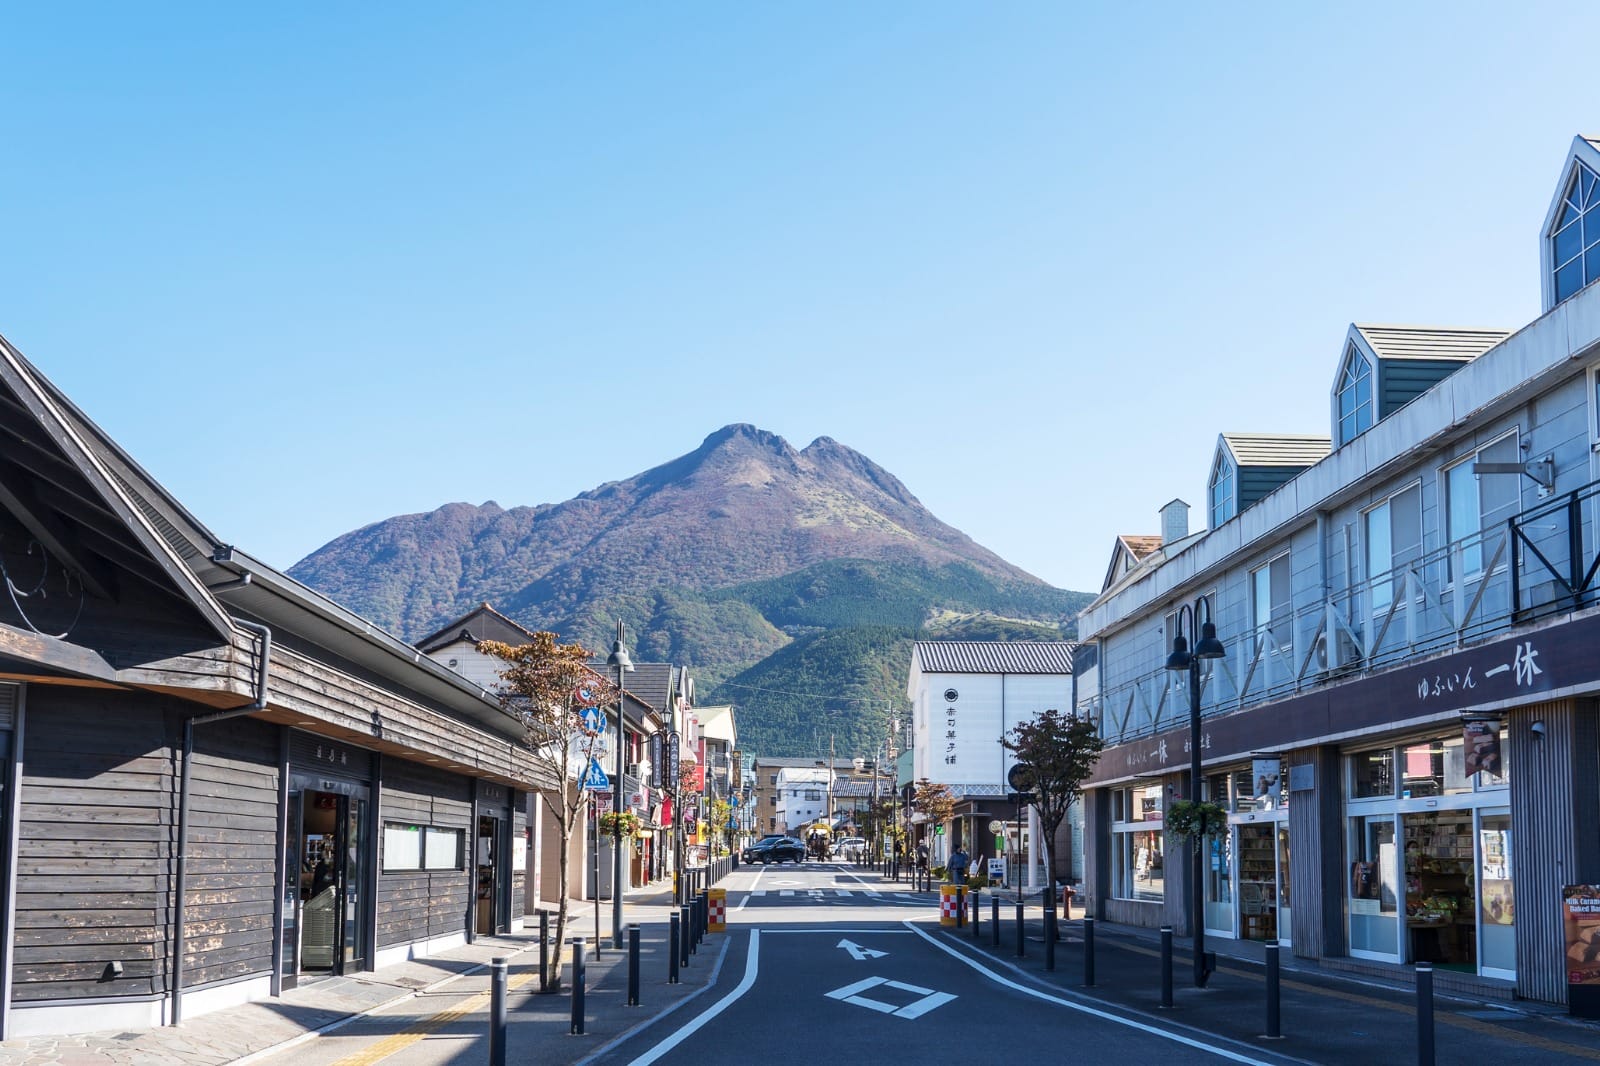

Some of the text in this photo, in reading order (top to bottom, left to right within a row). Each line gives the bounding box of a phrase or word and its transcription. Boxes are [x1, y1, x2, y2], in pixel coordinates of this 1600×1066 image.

[1417, 641, 1543, 700] ゆふいん 一休
